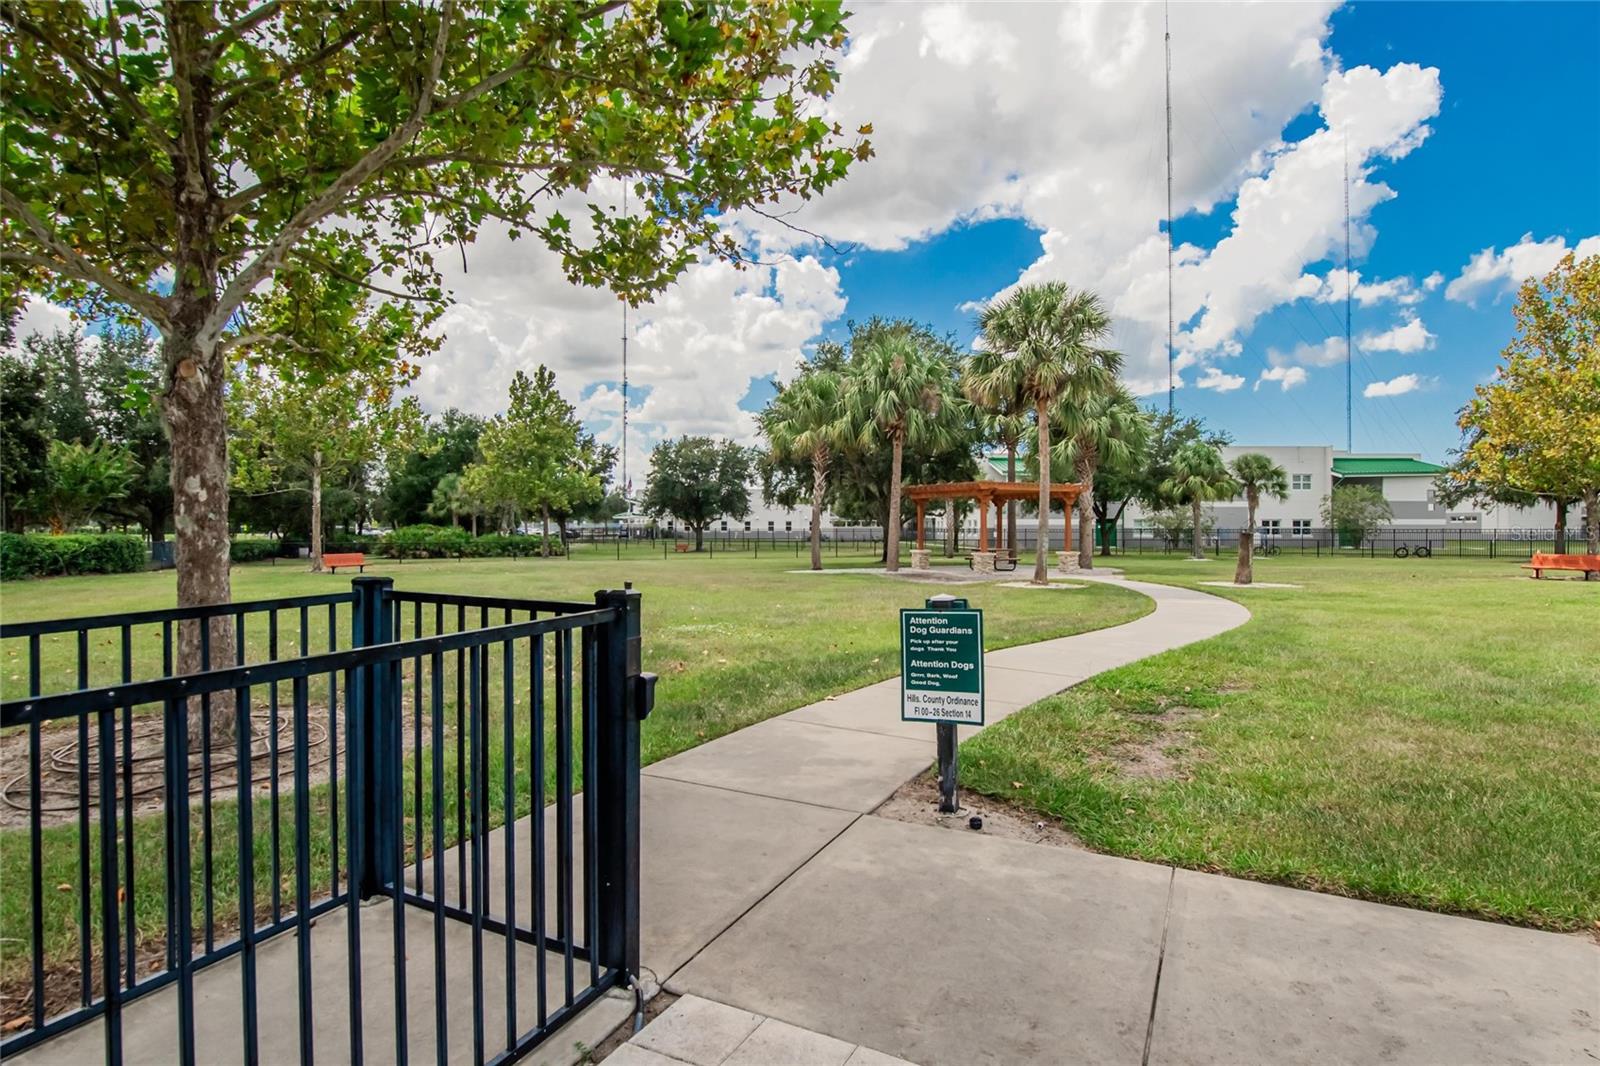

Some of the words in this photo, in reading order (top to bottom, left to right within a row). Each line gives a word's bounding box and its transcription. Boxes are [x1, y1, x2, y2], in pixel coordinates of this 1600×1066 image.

[910, 626, 927, 635] Dog
[929, 626, 972, 634] Guardians
[910, 660, 950, 668] Attention
[951, 661, 974, 670] Dogs
[922, 694, 945, 706] County
[946, 696, 978, 706] Ordinance
[941, 708, 964, 718] Section
[965, 710, 972, 718] 14
